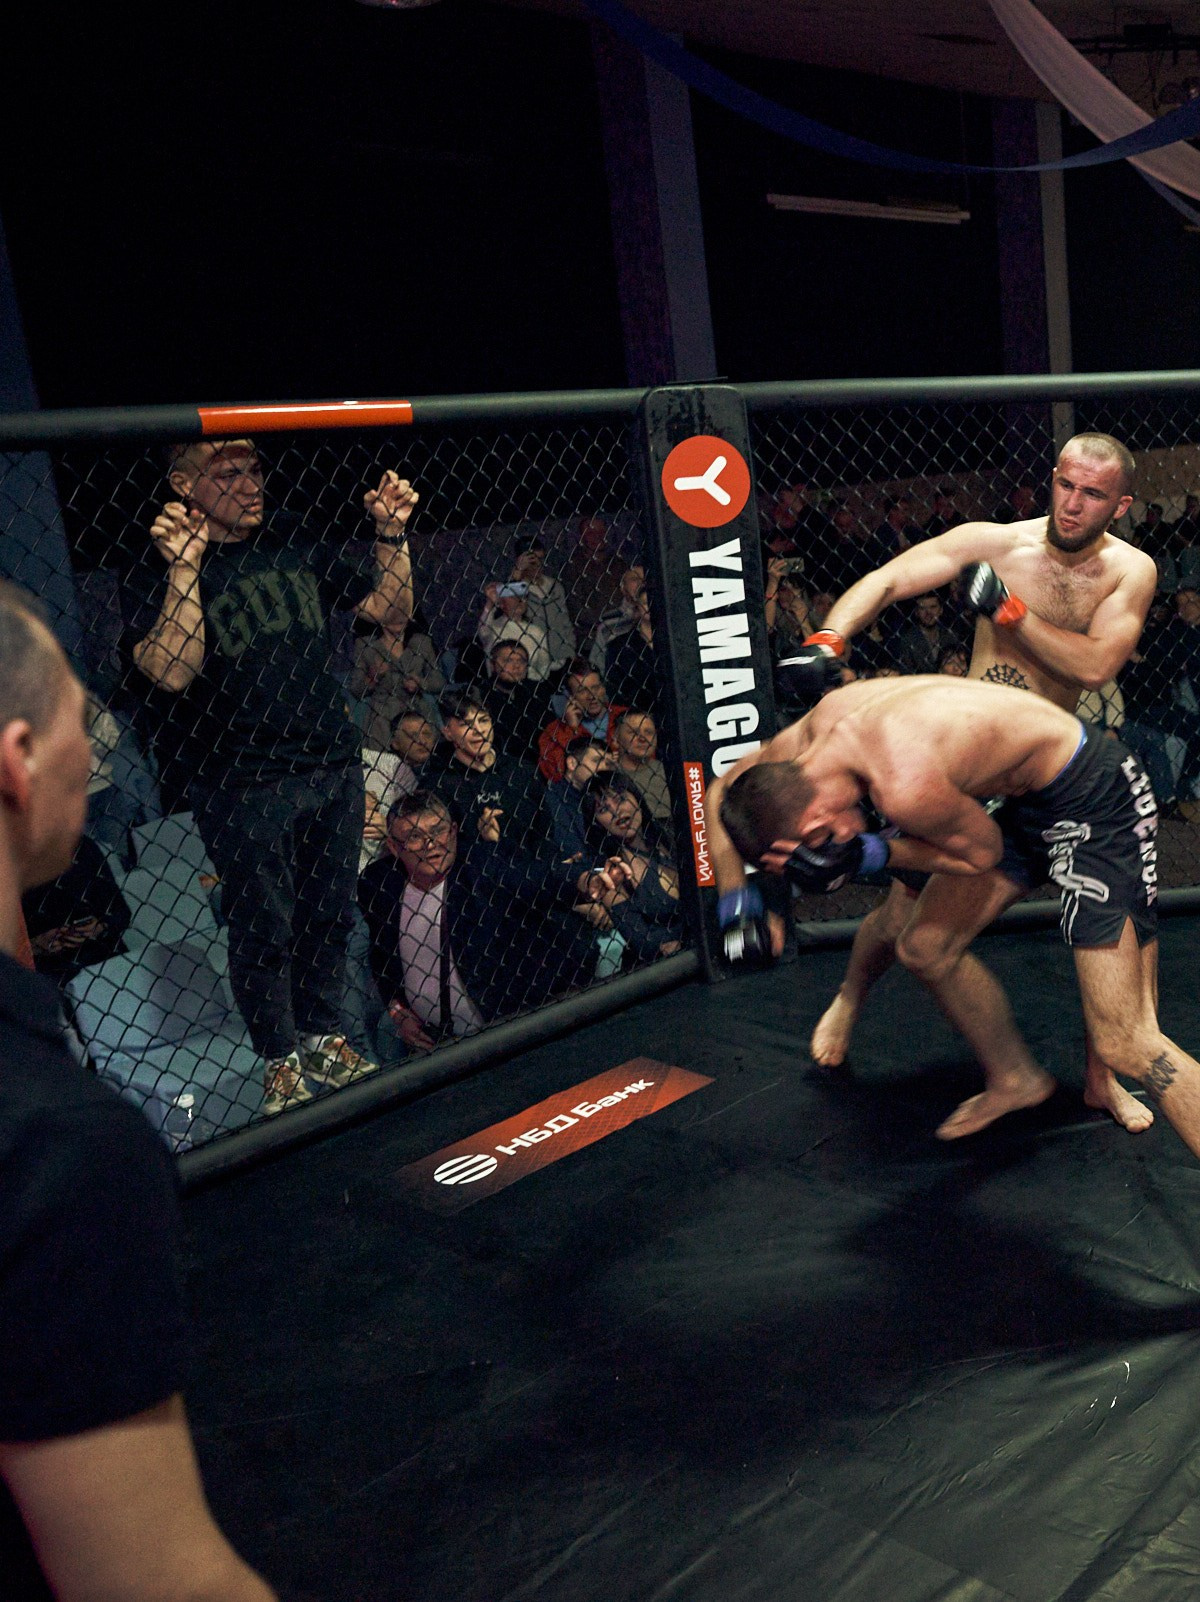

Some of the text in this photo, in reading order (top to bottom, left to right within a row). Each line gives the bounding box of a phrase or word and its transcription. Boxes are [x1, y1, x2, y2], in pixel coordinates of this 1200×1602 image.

[688, 766, 713, 882] #ЯМОГУЧИЙ
[495, 1078, 655, 1156] НБД Банк
